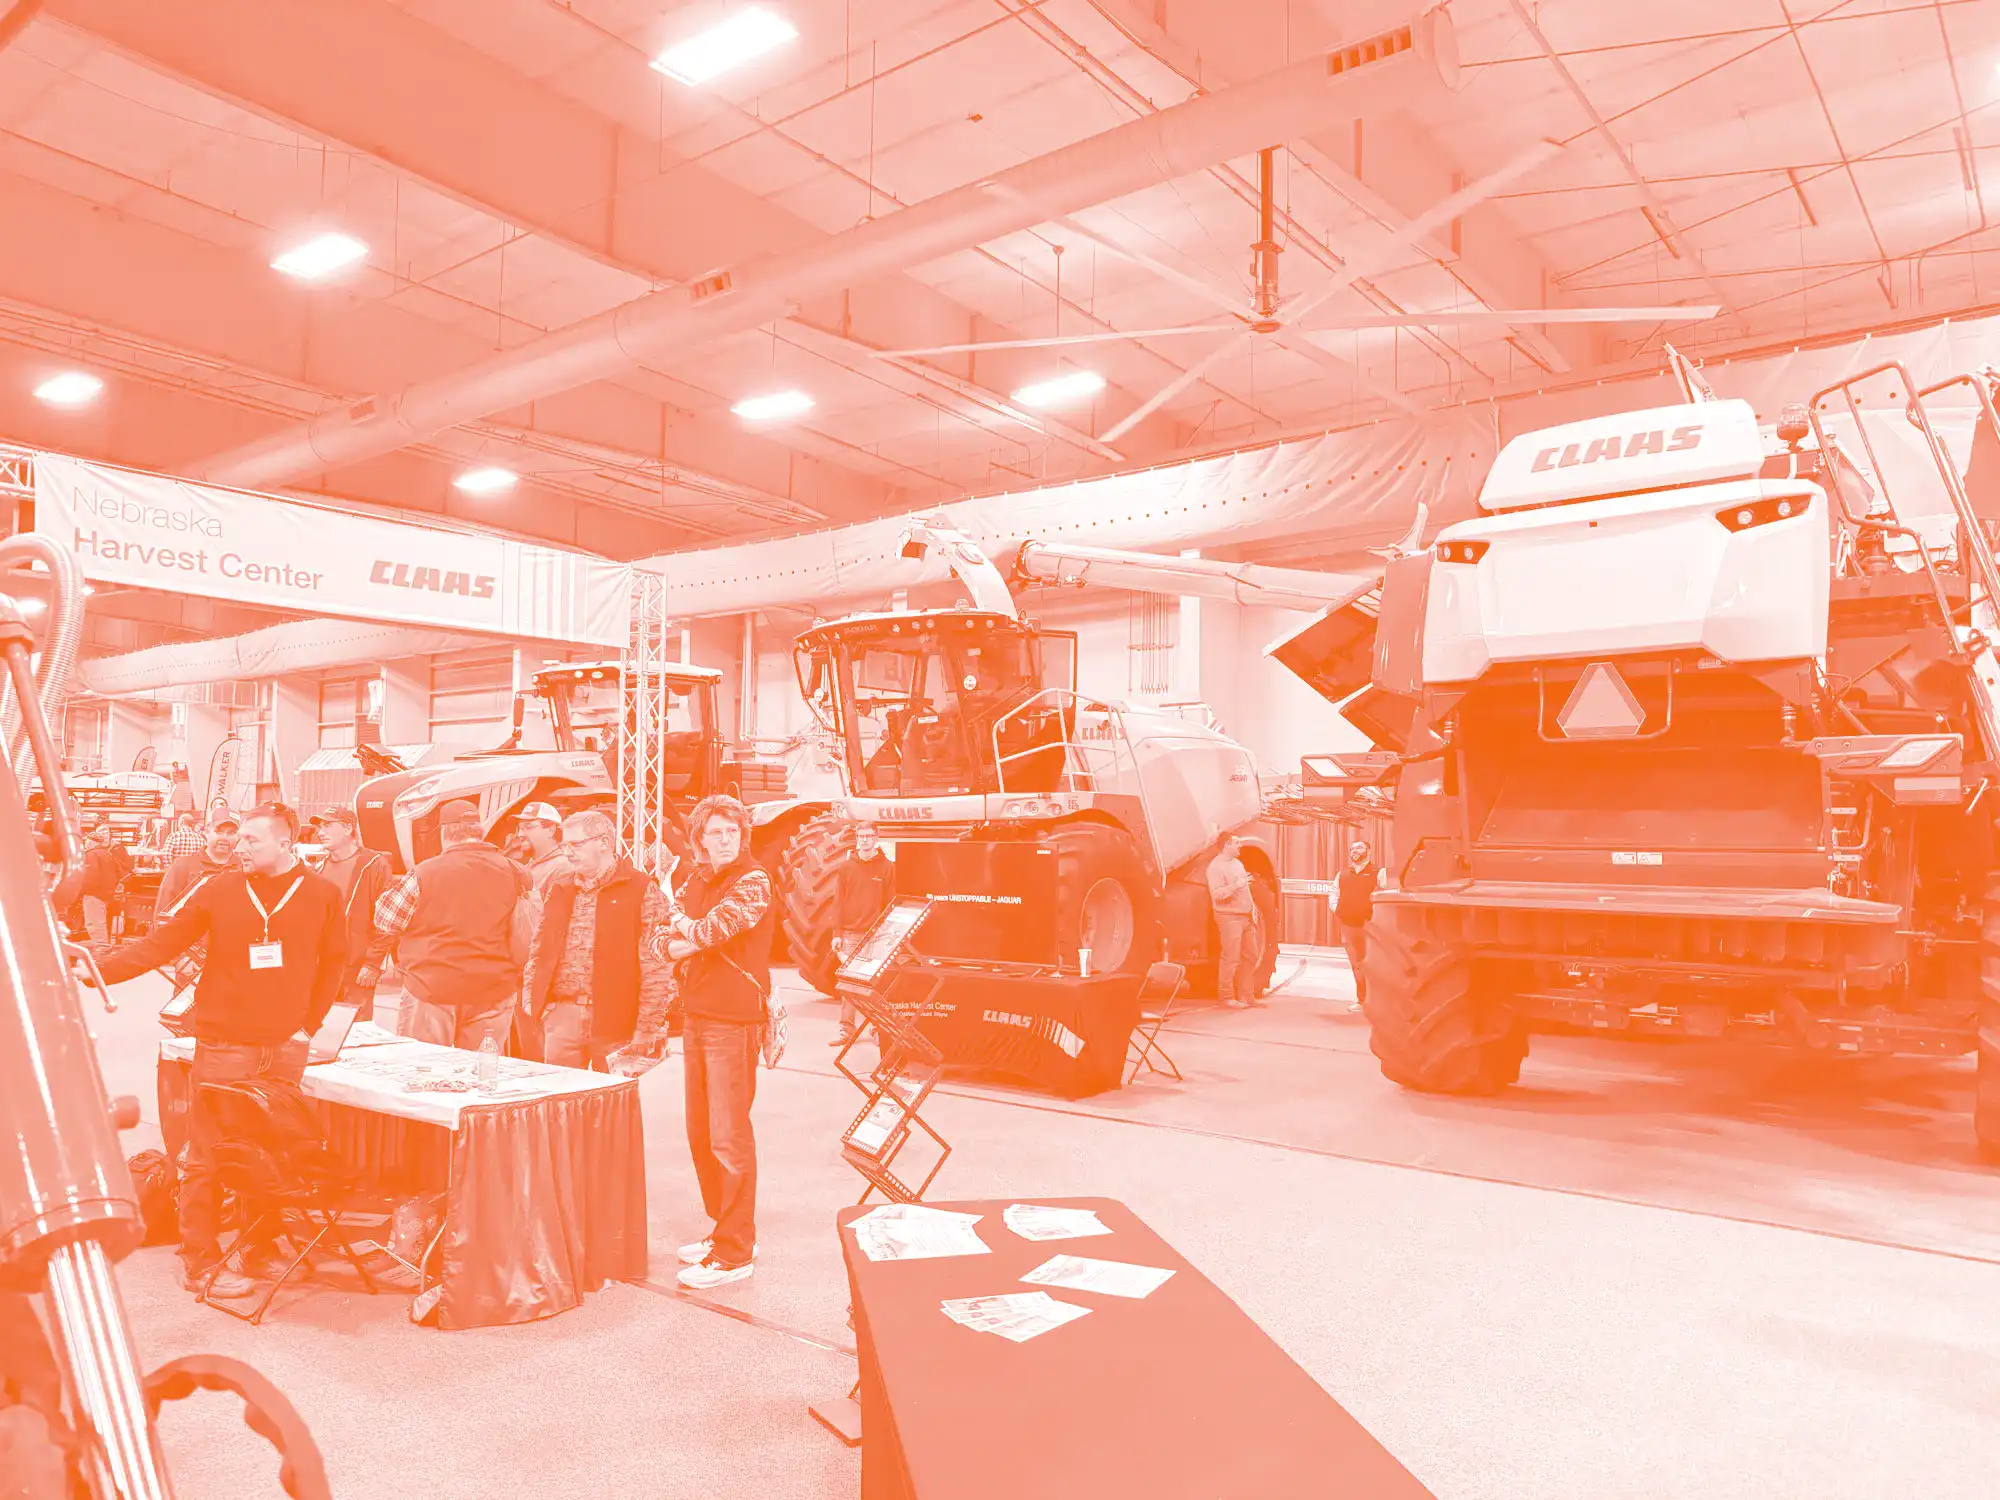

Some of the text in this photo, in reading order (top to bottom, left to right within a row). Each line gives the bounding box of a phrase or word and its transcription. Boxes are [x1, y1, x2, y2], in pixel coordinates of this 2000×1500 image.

[1530, 424, 1705, 473] CLAAS
[73, 485, 224, 538] Nebraska
[73, 526, 325, 591] Harvest Center
[369, 559, 496, 598] CLAAS
[217, 751, 231, 795] WALKER
[877, 806, 933, 820] CLAAS
[948, 893, 991, 904] UNSTOPPABLE
[996, 895, 1022, 905] JAGUAR
[934, 1001, 957, 1012] Center
[983, 1009, 1033, 1028] CLAAS
